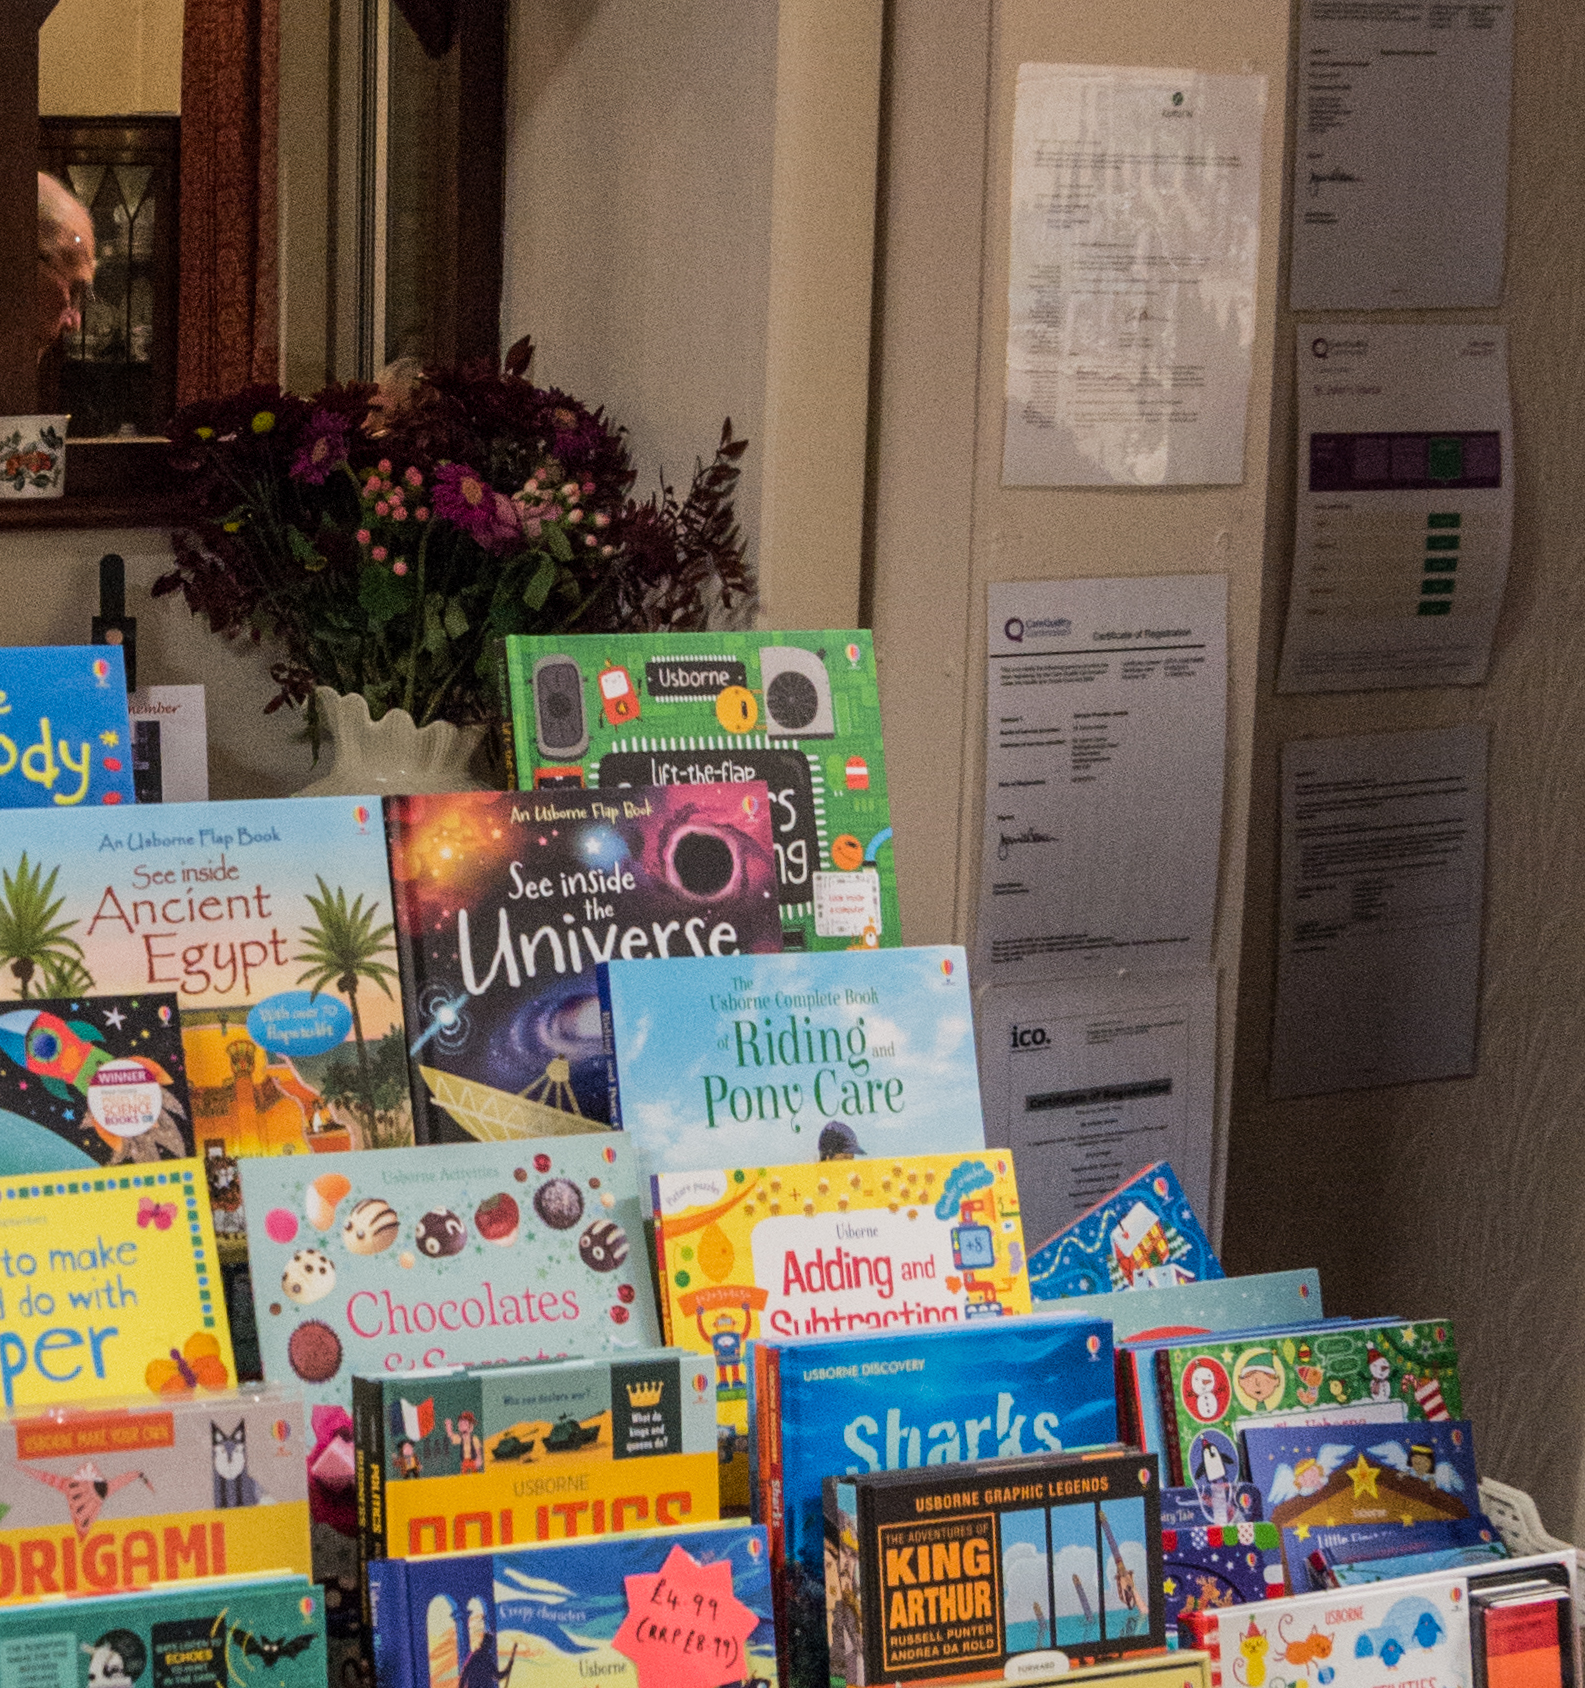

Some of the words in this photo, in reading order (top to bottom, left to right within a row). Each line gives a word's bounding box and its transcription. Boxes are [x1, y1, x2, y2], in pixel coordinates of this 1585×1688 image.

[658, 667, 730, 688] Usborne
[510, 806, 531, 824] An
[533, 806, 588, 822] Usborne
[590, 801, 620, 823] Flap
[622, 799, 653, 818] Book
[99, 832, 123, 852] An
[127, 827, 195, 851] Usborne
[199, 828, 233, 850] Flap
[236, 826, 282, 845] Book
[133, 864, 177, 888] See
[180, 853, 240, 884] inside
[508, 861, 555, 901] See
[560, 861, 636, 898] inside
[86, 882, 273, 937] Ancient
[582, 898, 615, 921] the
[142, 928, 290, 996] Egypt
[457, 907, 740, 996] Universe
[709, 991, 771, 1012] Usborne
[775, 989, 840, 1012] Complete
[843, 987, 880, 1006] Book
[732, 976, 754, 993] The
[717, 1034, 730, 1052] of
[733, 1016, 869, 1076] Riding
[871, 1040, 896, 1059] and
[97, 1070, 148, 1085] WINNER
[703, 1075, 804, 1132] Pony
[814, 1071, 905, 1118] Care
[837, 1223, 879, 1241] Usborne
[48, 1236, 139, 1274] make
[782, 1246, 893, 1299] Adding
[901, 1254, 937, 1282] and
[18, 1283, 57, 1316] do
[70, 1274, 140, 1312] with
[346, 1285, 580, 1340] Chocolates
[803, 1365, 859, 1383] USBORNE
[861, 1357, 926, 1379] DISCOVERY
[843, 1391, 1063, 1476] Sharks
[514, 1475, 590, 1497] USBORNE
[915, 1491, 980, 1513] USBORNE
[985, 1483, 1044, 1507] GRAPHIC
[1047, 1476, 1110, 1501] LEGENDS
[885, 1538, 992, 1588] KING
[888, 1585, 994, 1631] ARTHUR
[1324, 1606, 1365, 1626] USBORNE
